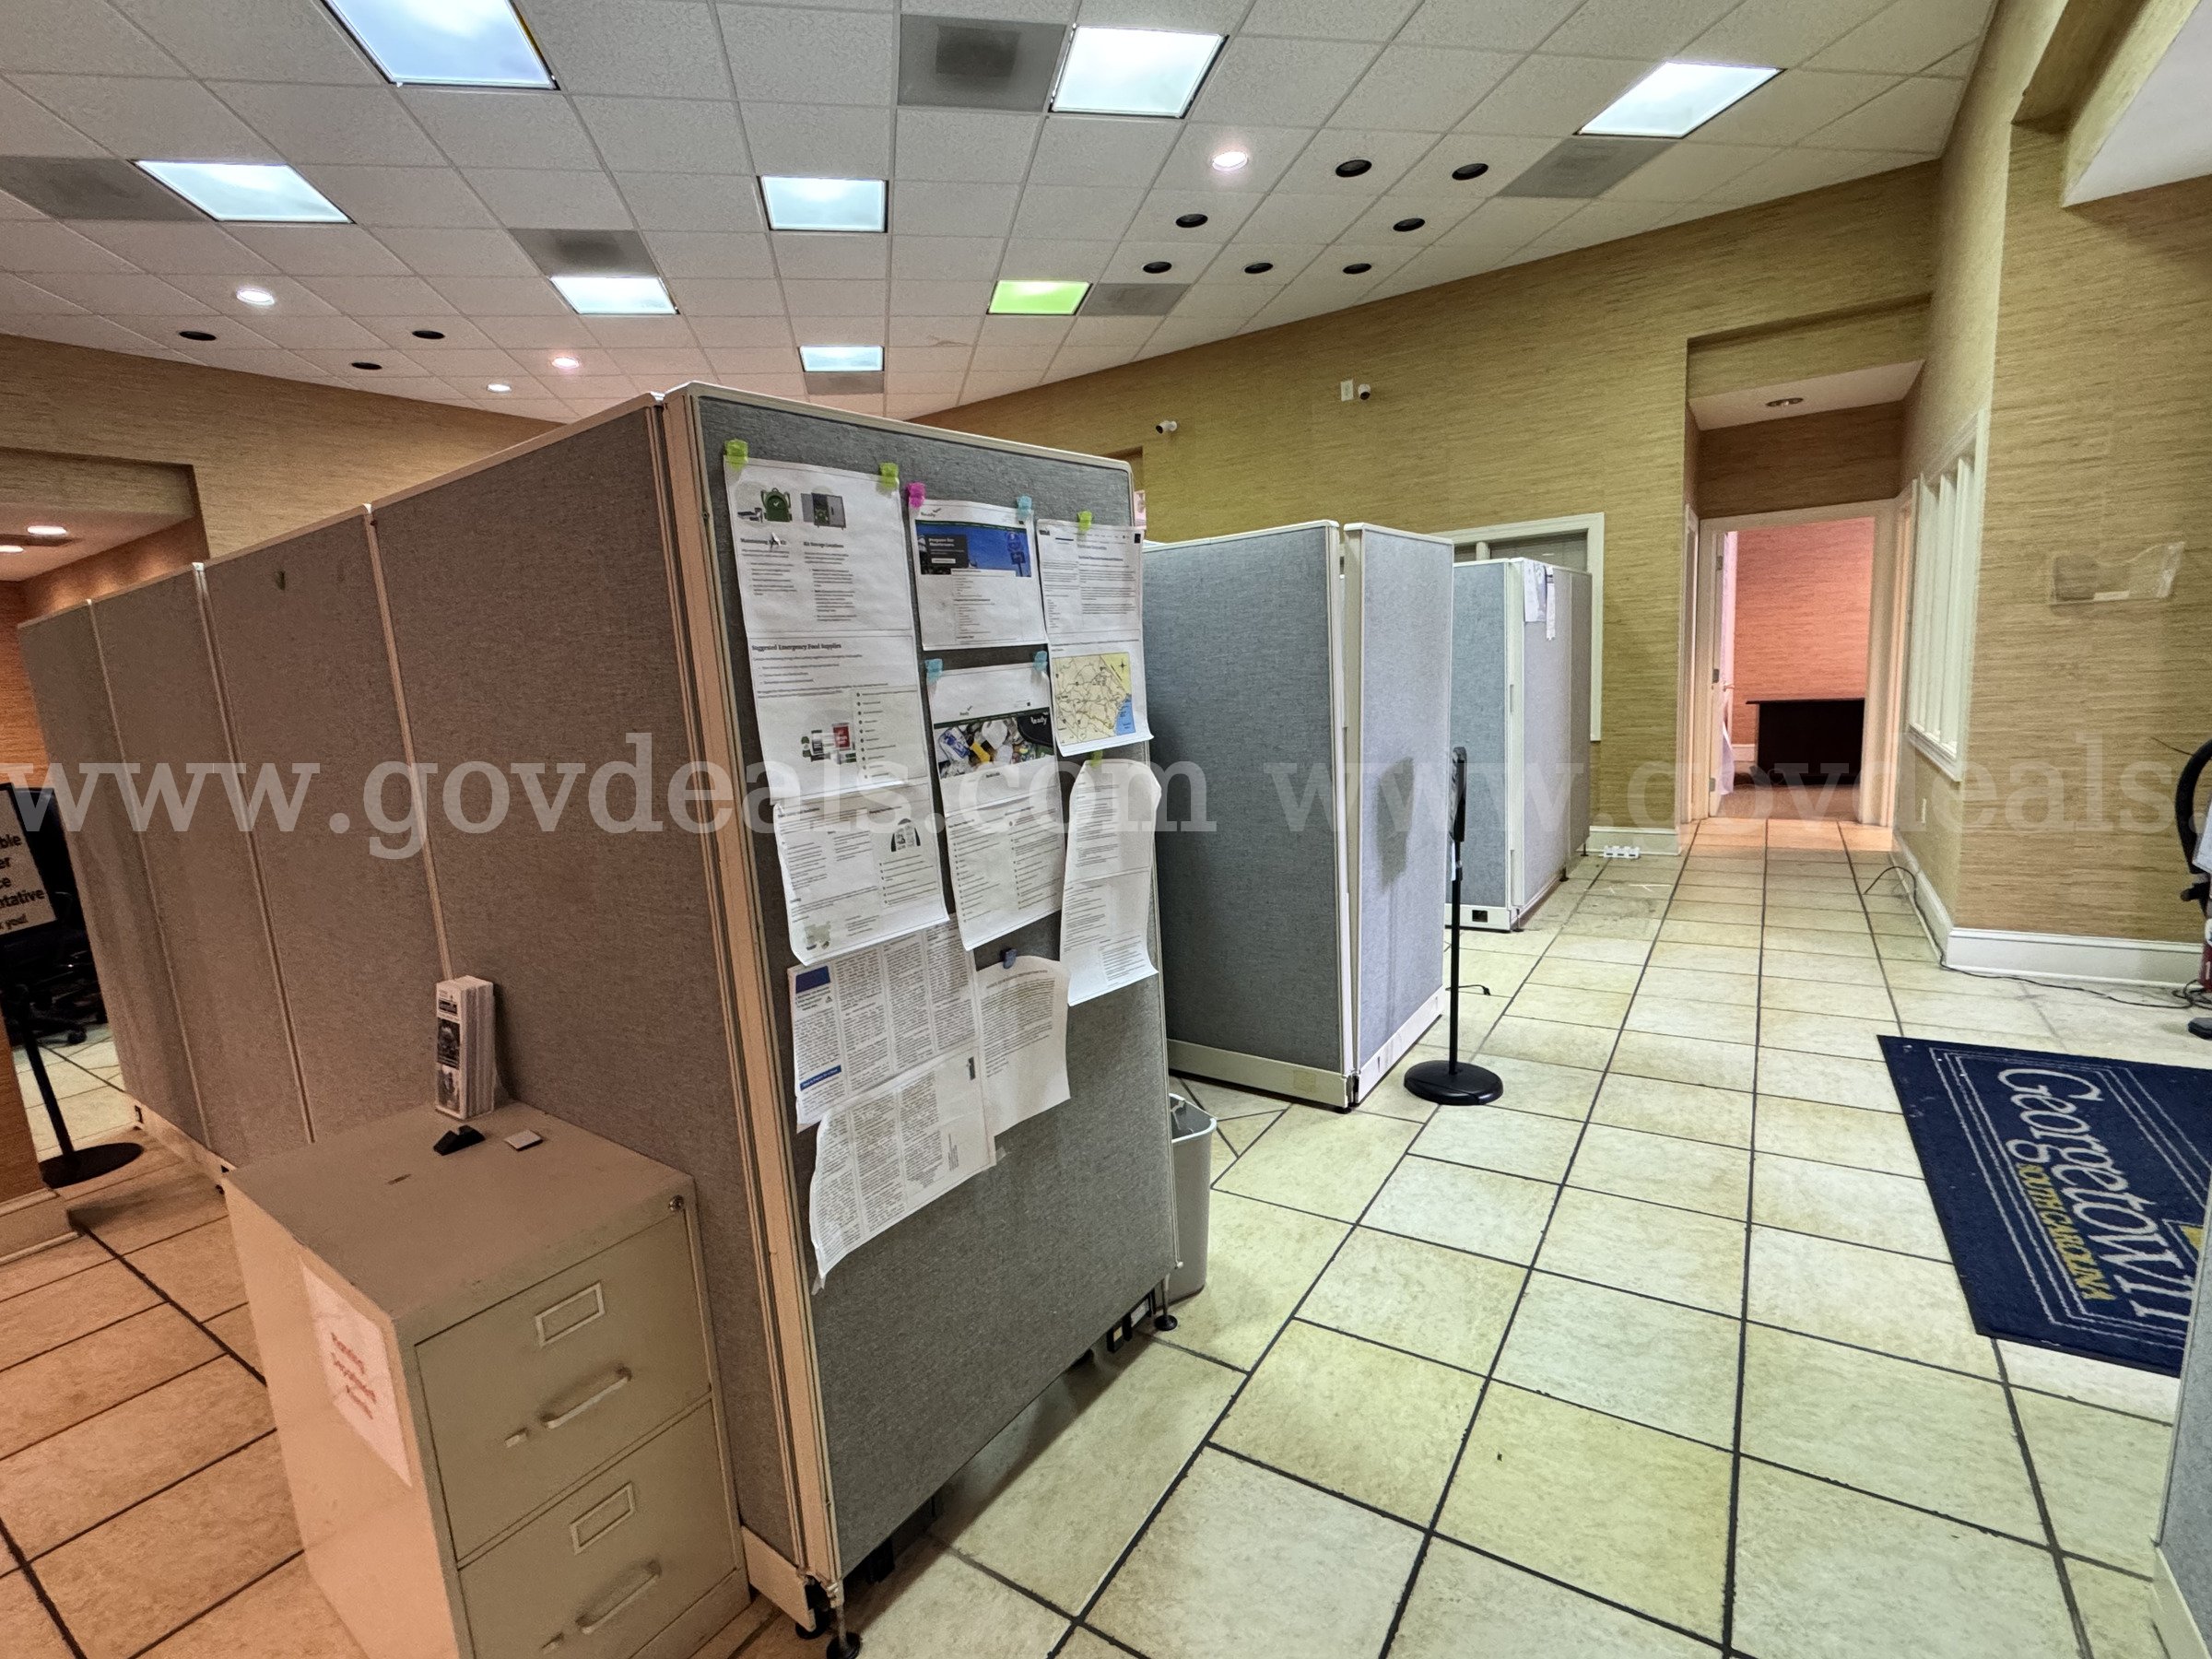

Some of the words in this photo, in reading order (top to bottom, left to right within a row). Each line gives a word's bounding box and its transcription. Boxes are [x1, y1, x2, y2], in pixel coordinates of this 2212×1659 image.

[778, 643, 807, 652] Emergency
[821, 643, 842, 652] Supplies
[2016, 1162, 2066, 1215] SOUTH
[2040, 1209, 2117, 1300] CAROLINA
